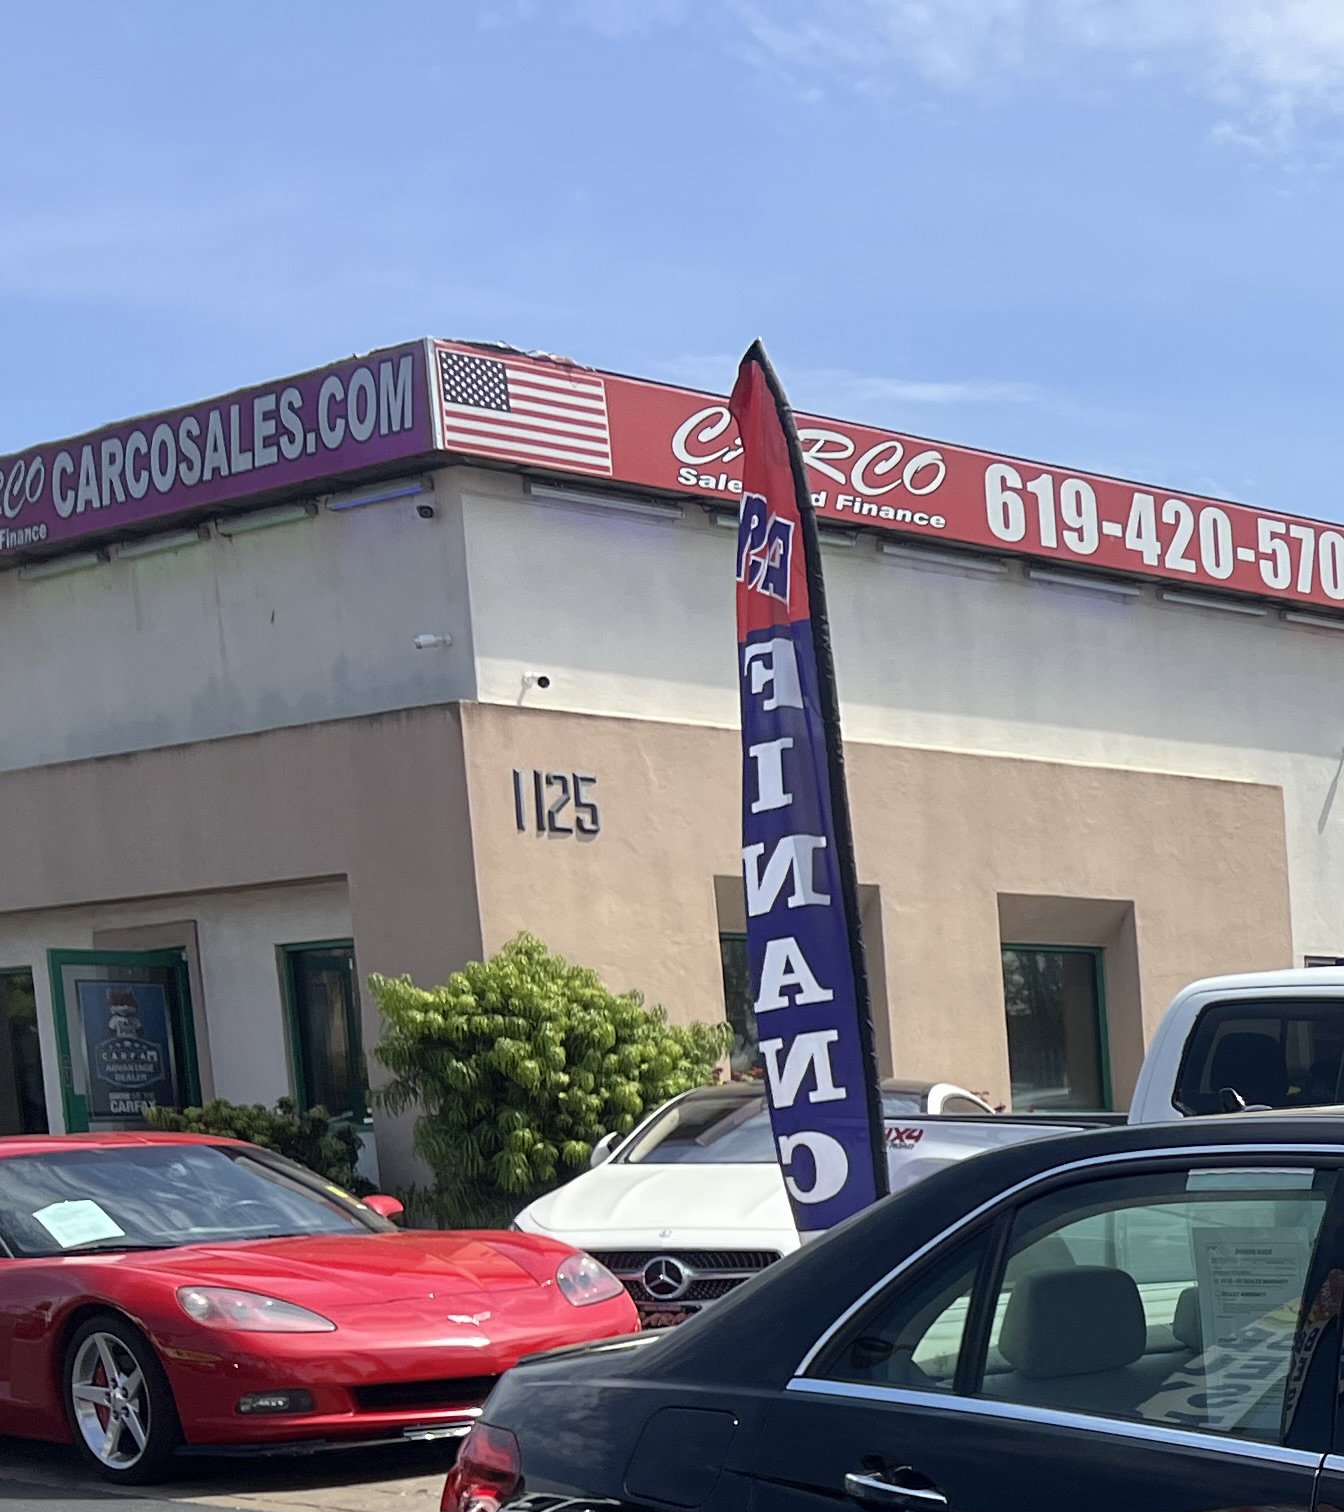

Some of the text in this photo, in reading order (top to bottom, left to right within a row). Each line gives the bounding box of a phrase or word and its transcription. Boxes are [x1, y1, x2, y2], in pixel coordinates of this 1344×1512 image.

[52, 356, 414, 518] CARCOSALES.COM
[672, 406, 946, 497] CRCO
[677, 467, 742, 495] Sale
[836, 495, 946, 529] Finance
[512, 768, 602, 837] 1125
